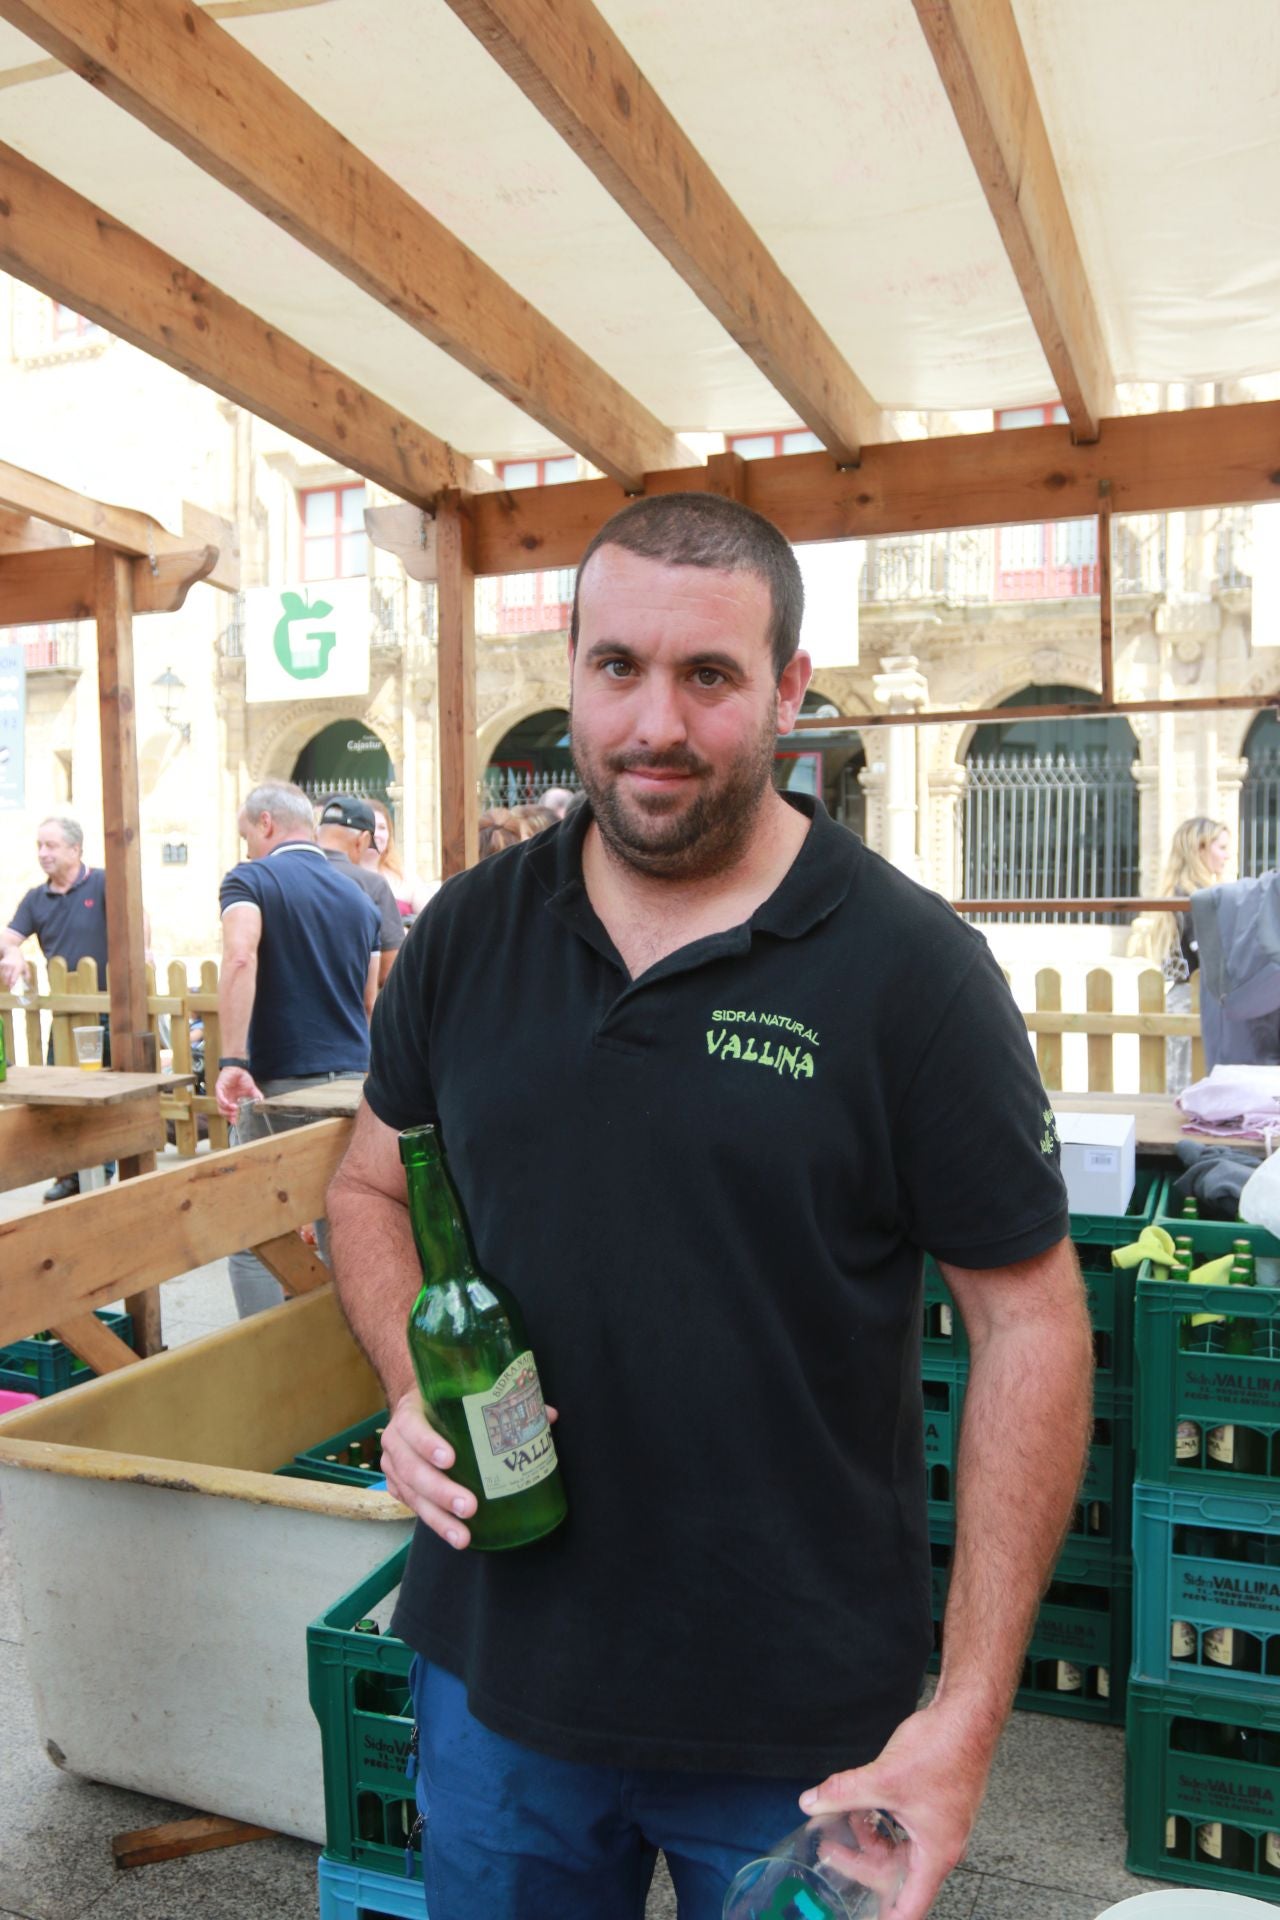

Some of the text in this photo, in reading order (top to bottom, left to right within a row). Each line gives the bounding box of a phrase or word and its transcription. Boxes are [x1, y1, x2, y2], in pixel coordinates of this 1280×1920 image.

[711, 1009, 820, 1046] SIDRA NATURAL
[706, 1028, 814, 1080] VALLINA
[1213, 1575, 1280, 1597] VALLINA
